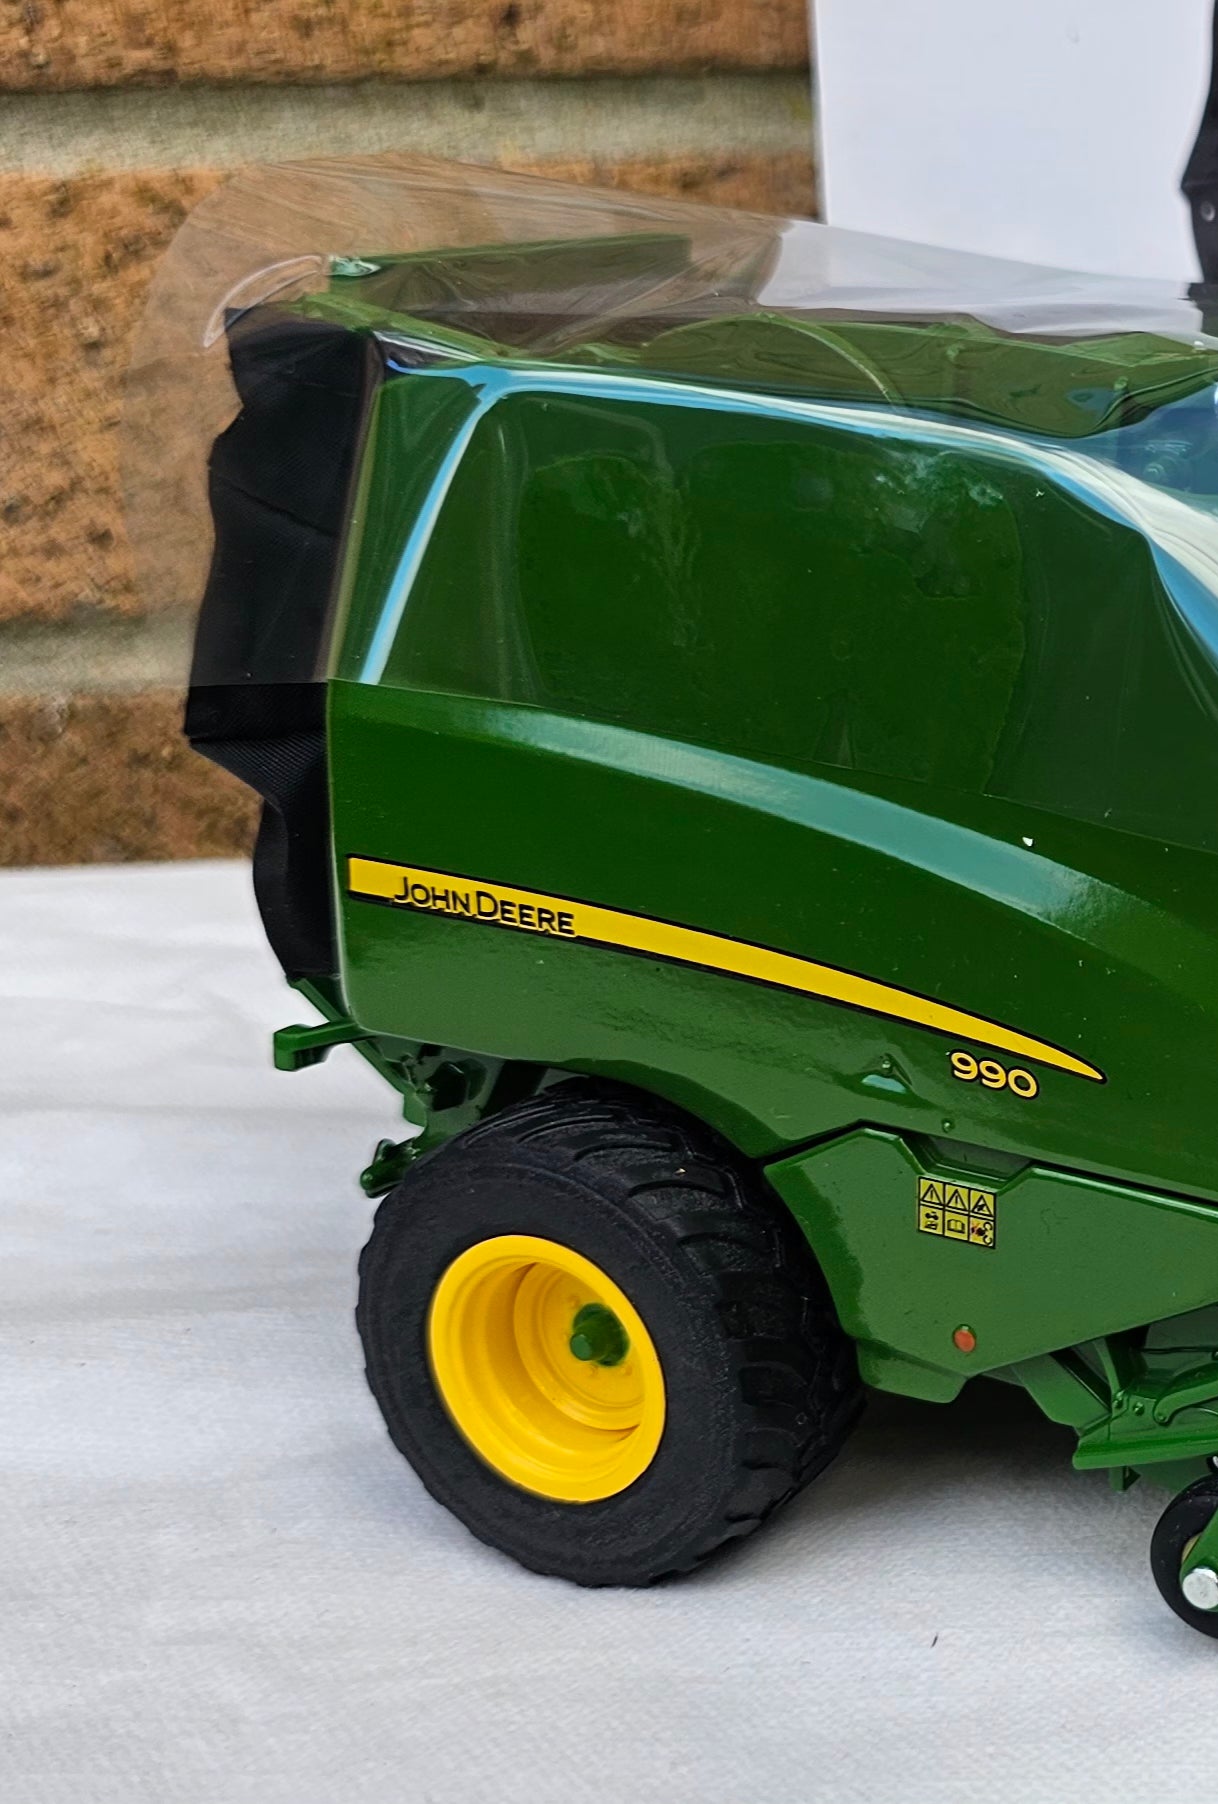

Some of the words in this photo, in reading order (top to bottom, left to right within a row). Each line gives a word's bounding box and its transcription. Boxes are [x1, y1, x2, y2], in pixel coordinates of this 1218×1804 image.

[394, 875, 471, 916] JOHN
[474, 890, 576, 936] DEERE
[950, 1050, 1039, 1099] 990
